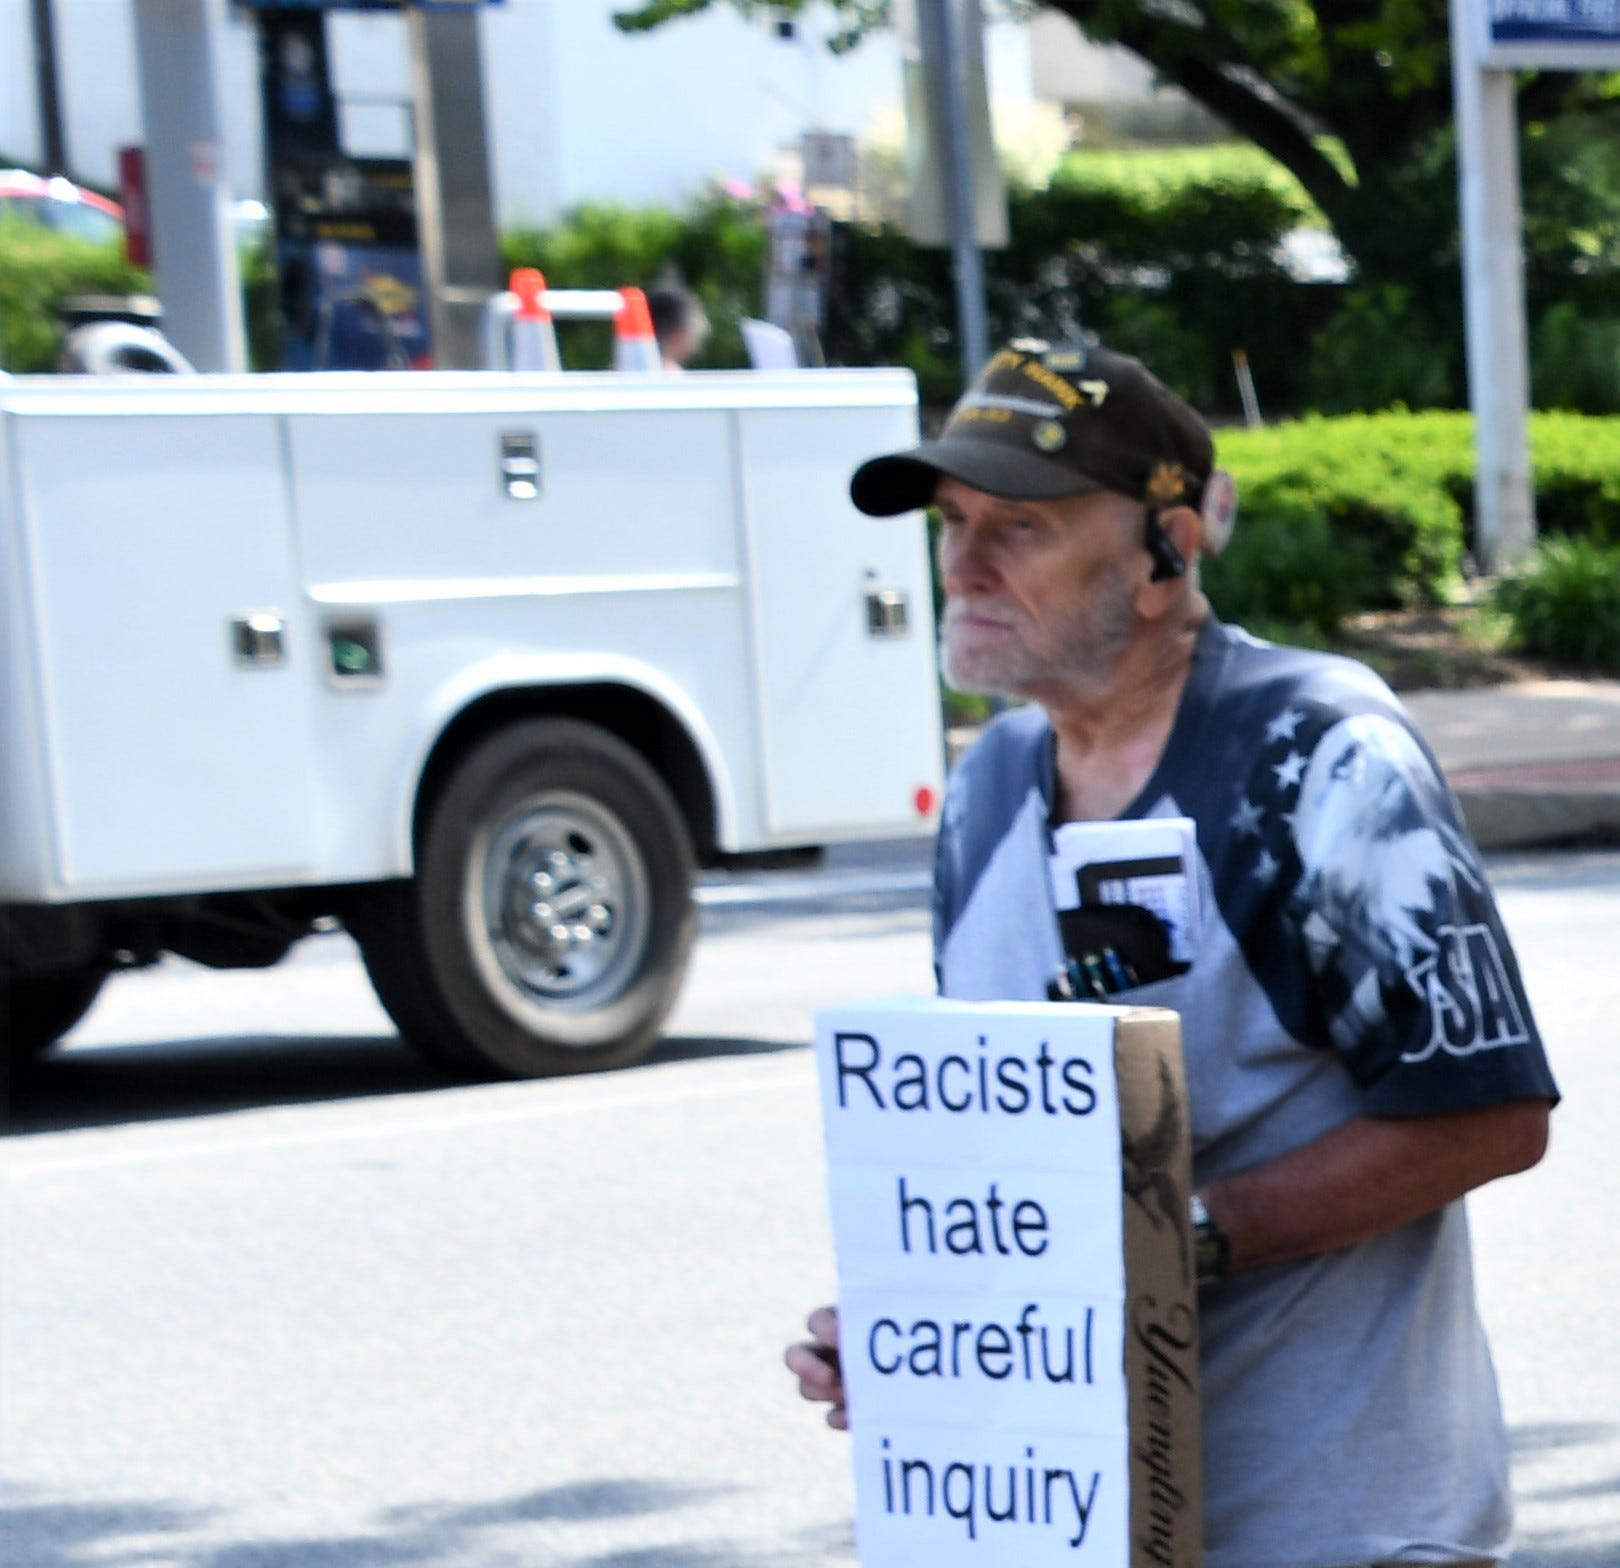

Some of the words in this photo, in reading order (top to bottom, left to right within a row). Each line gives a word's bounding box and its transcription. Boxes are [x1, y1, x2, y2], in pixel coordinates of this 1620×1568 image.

[834, 1032, 1098, 1117] Racists
[898, 1176, 1050, 1257] hate
[868, 1303, 1096, 1386] careful
[879, 1437, 1102, 1549] inquiry
